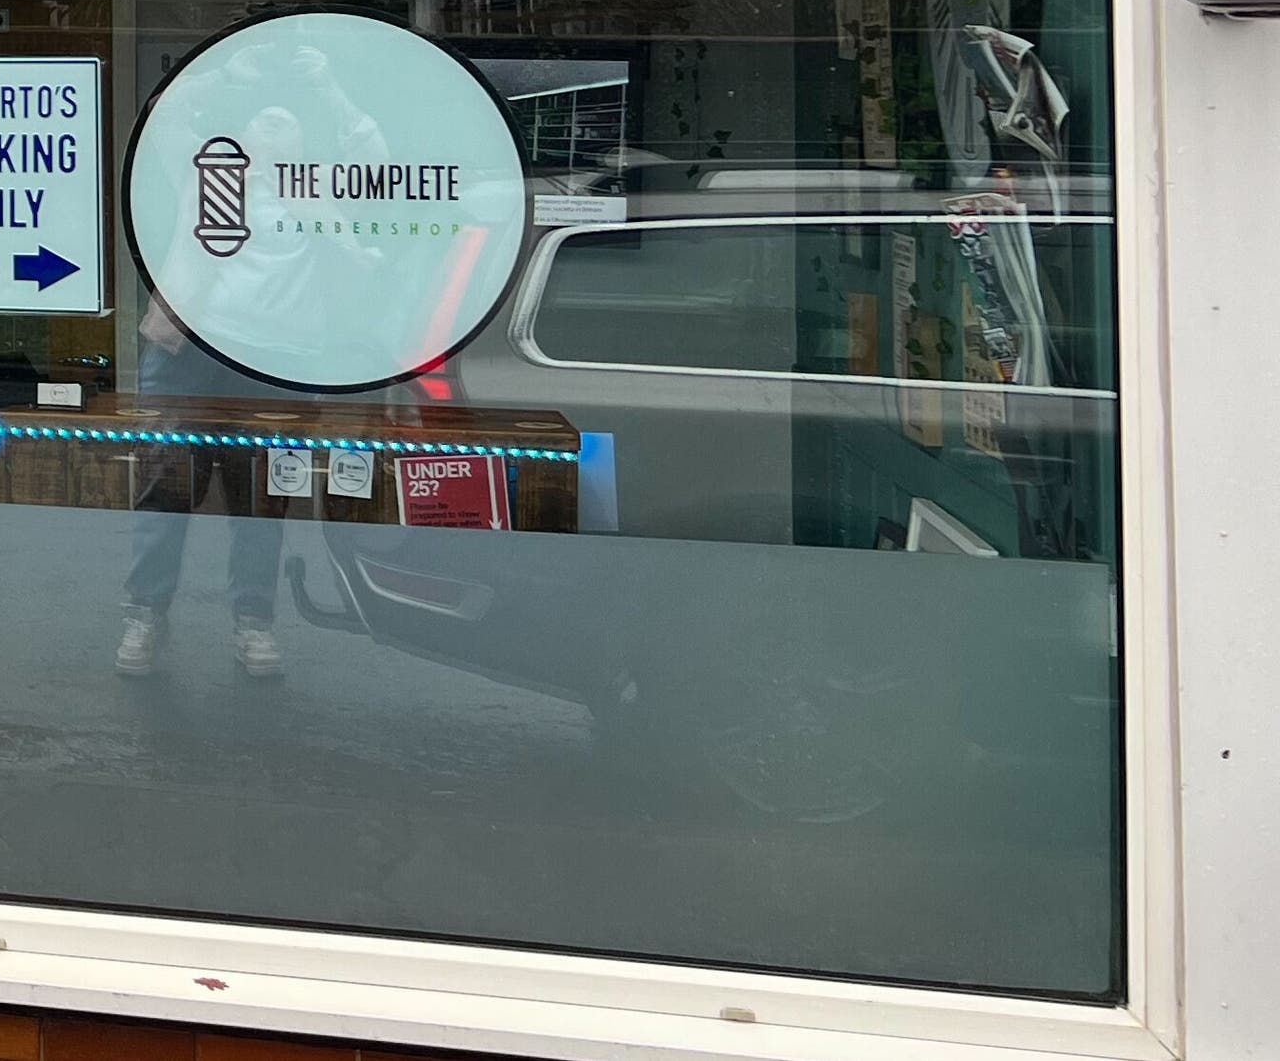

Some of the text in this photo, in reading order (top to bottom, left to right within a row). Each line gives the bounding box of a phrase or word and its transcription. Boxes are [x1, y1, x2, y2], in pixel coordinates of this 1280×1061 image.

[274, 163, 459, 201] THE COMPLETE
[276, 220, 460, 235] BARBERSHOP
[406, 461, 472, 479] UNDER
[408, 480, 439, 497] 25?
